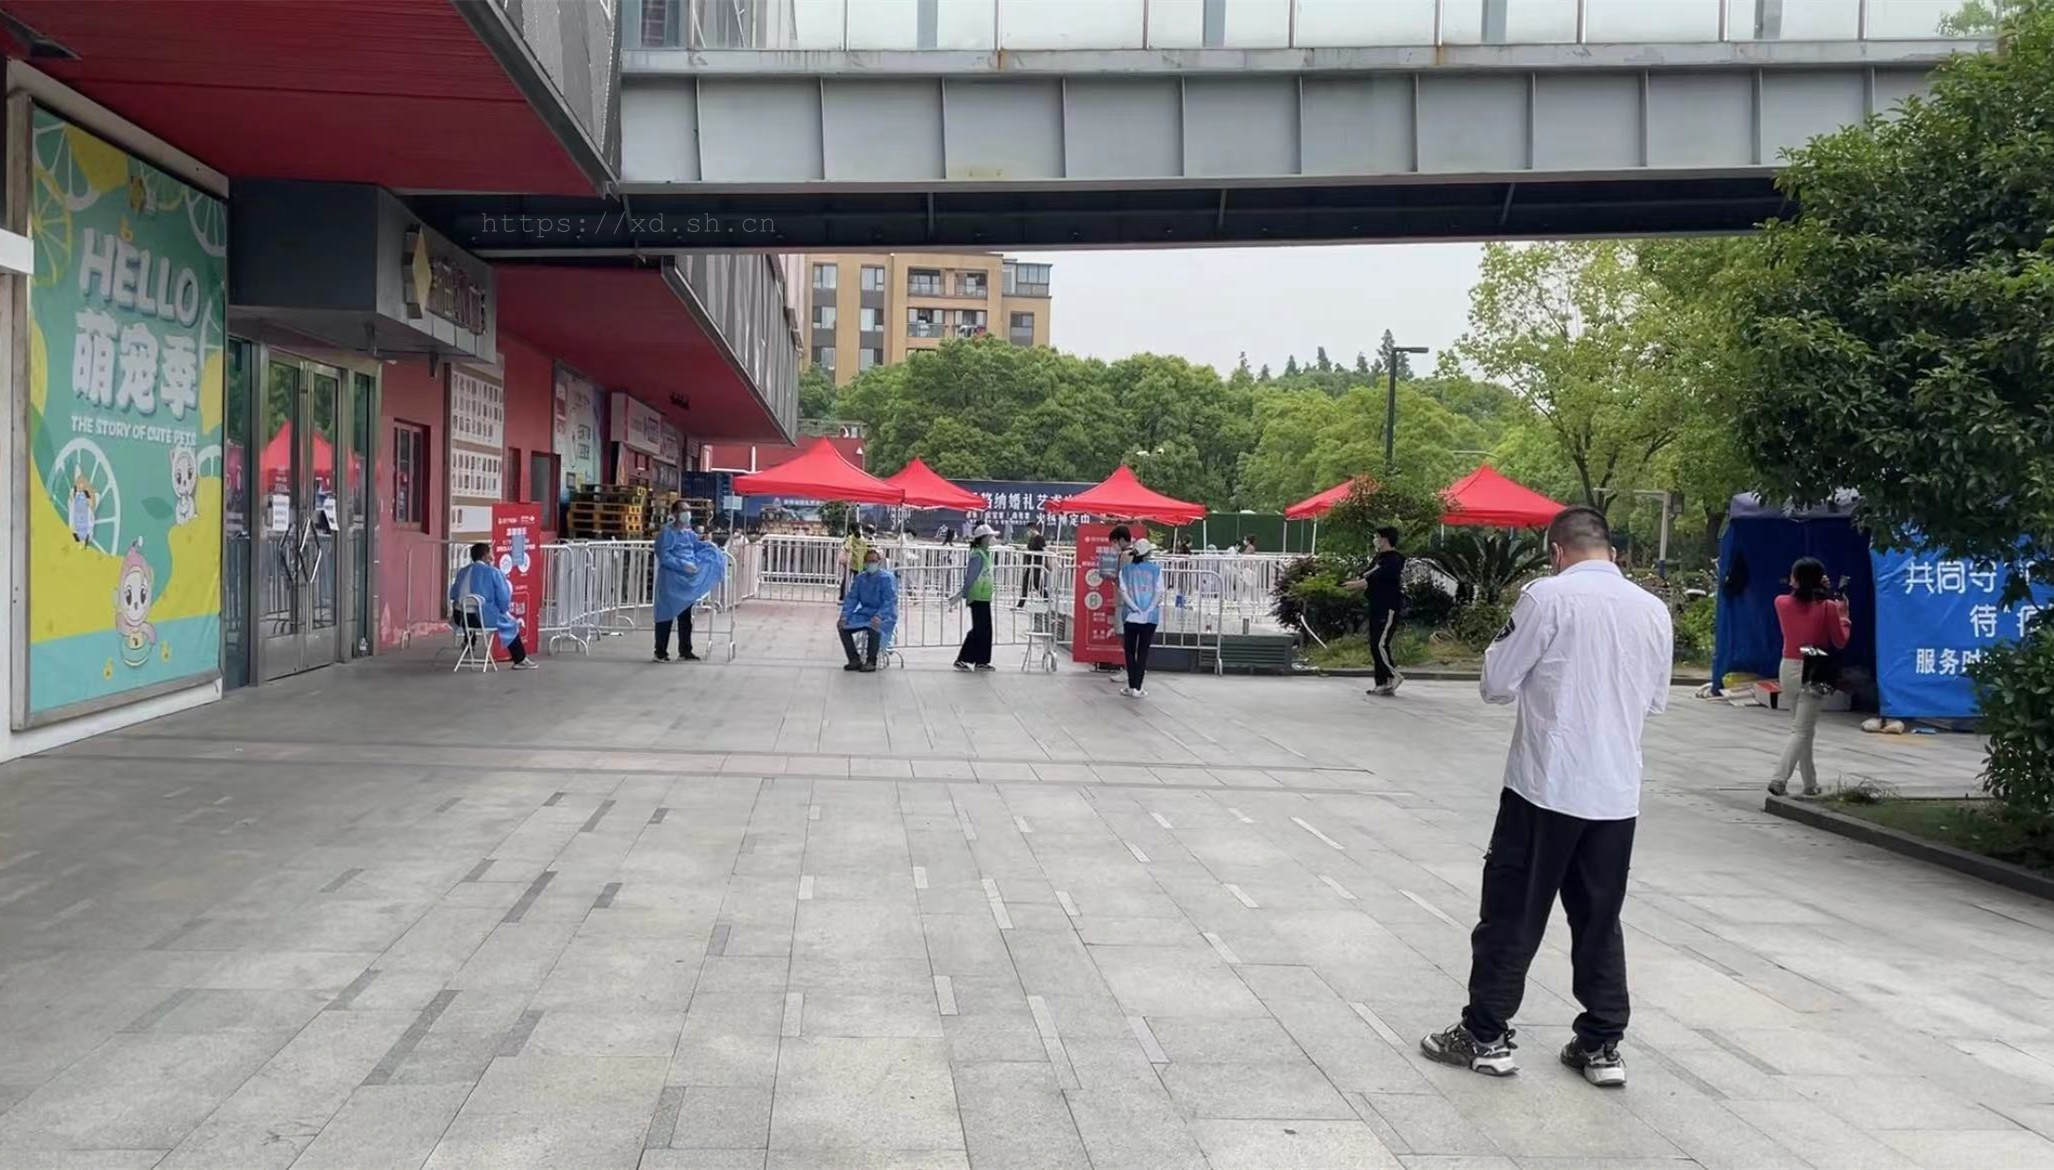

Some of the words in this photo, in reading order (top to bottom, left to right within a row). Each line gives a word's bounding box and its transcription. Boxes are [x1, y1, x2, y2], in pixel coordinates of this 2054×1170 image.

[79, 227, 198, 326] HELLO
[73, 307, 198, 420] 萌宠季
[71, 415, 94, 433] THE
[95, 419, 131, 438] STORY
[132, 424, 147, 440] OF
[147, 426, 172, 444] CUTE
